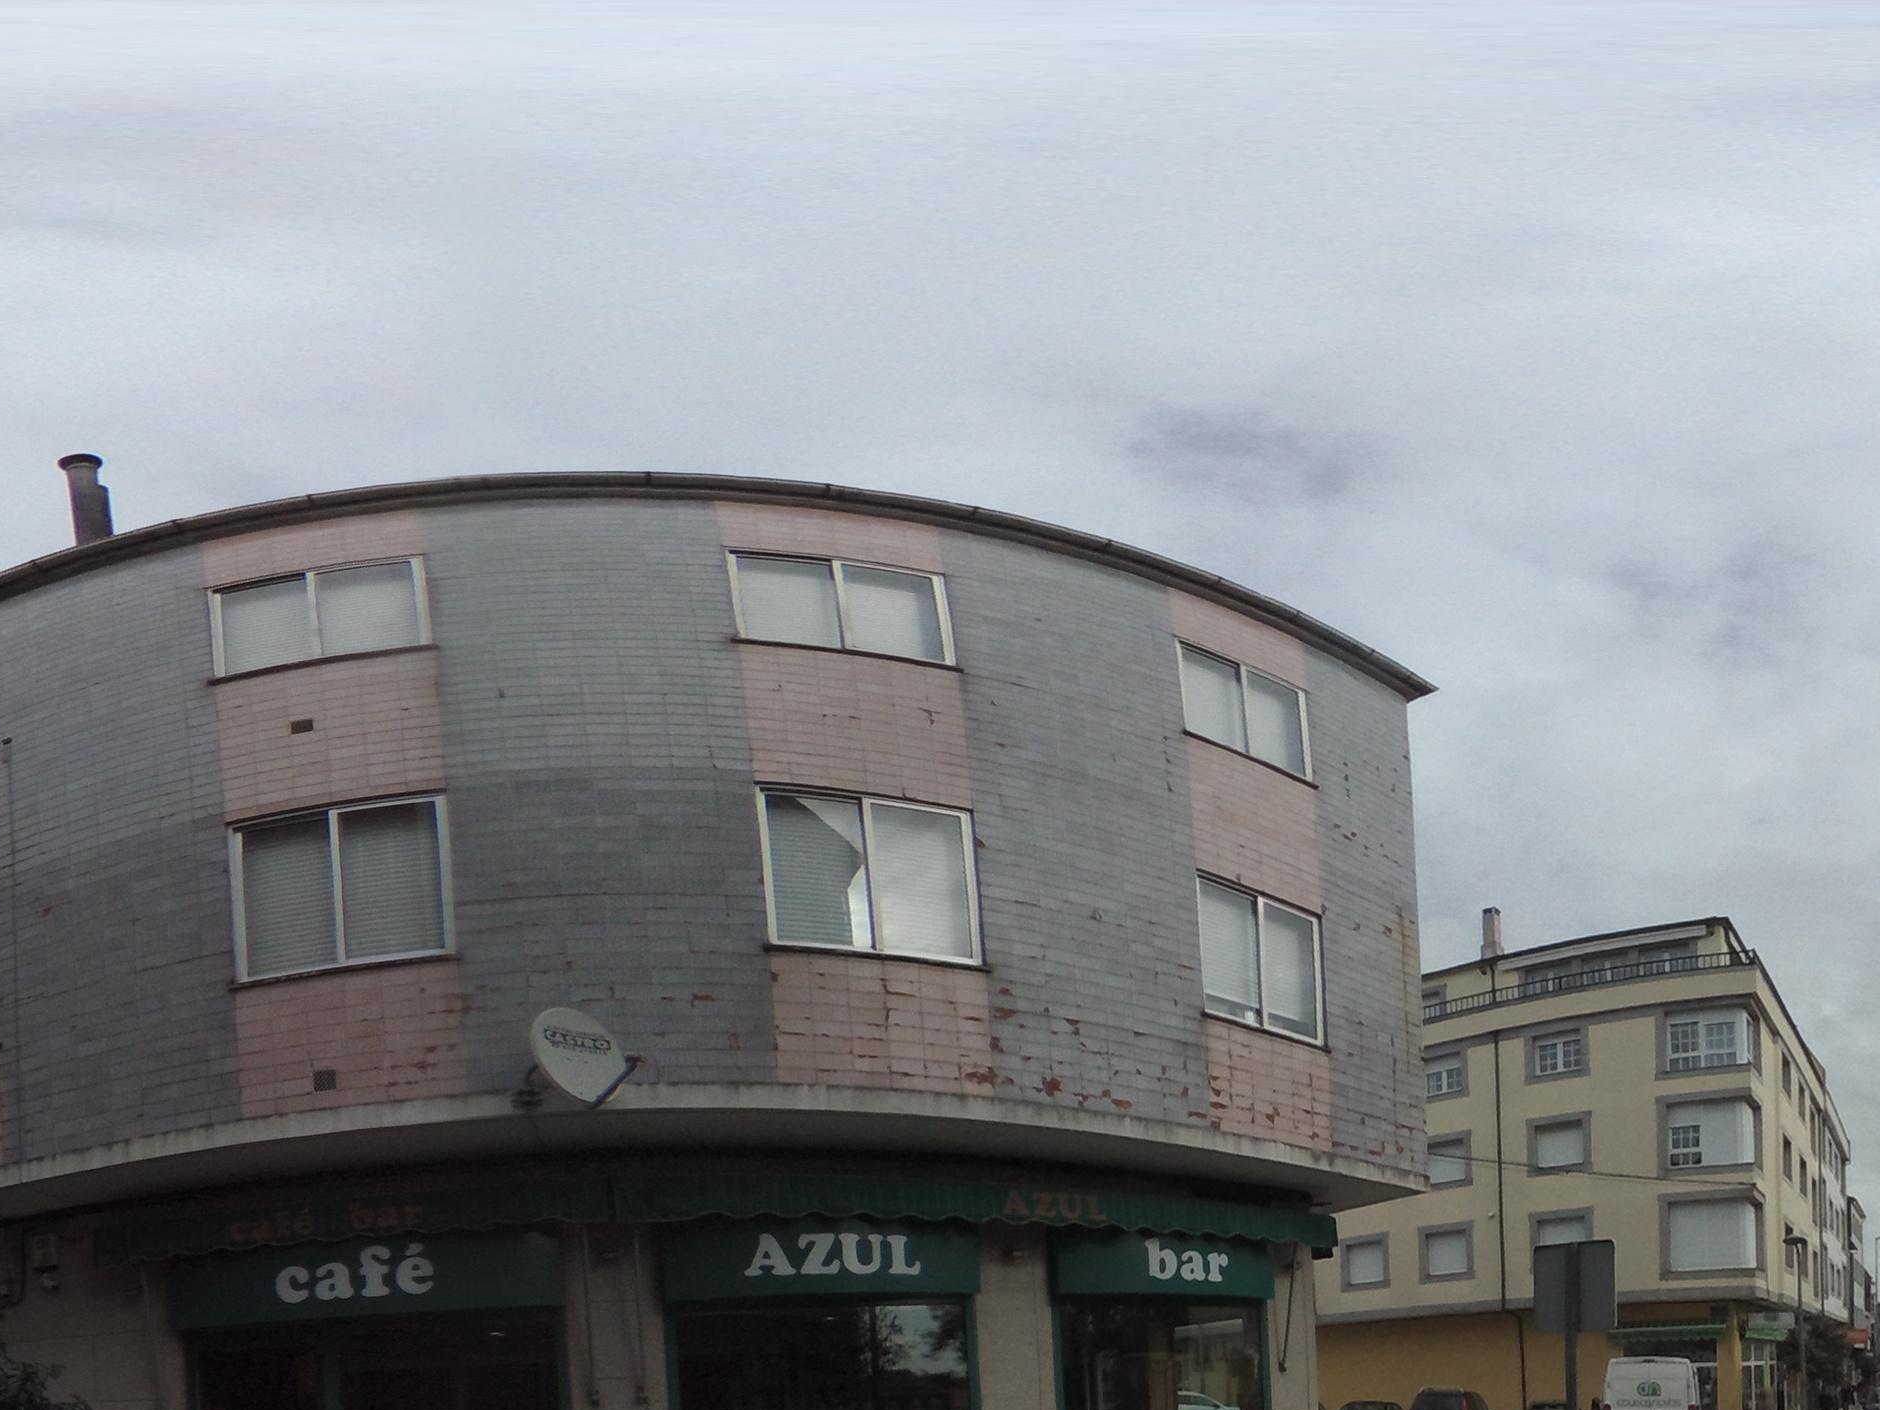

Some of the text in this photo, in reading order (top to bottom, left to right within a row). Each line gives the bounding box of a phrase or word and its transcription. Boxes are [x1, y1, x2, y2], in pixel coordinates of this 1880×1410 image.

[544, 1029, 611, 1051] CASTRO
[1002, 1186, 1107, 1222] AZUL
[274, 1242, 436, 1305] café
[743, 1231, 922, 1278] AZUL
[1145, 1238, 1230, 1284] bar
